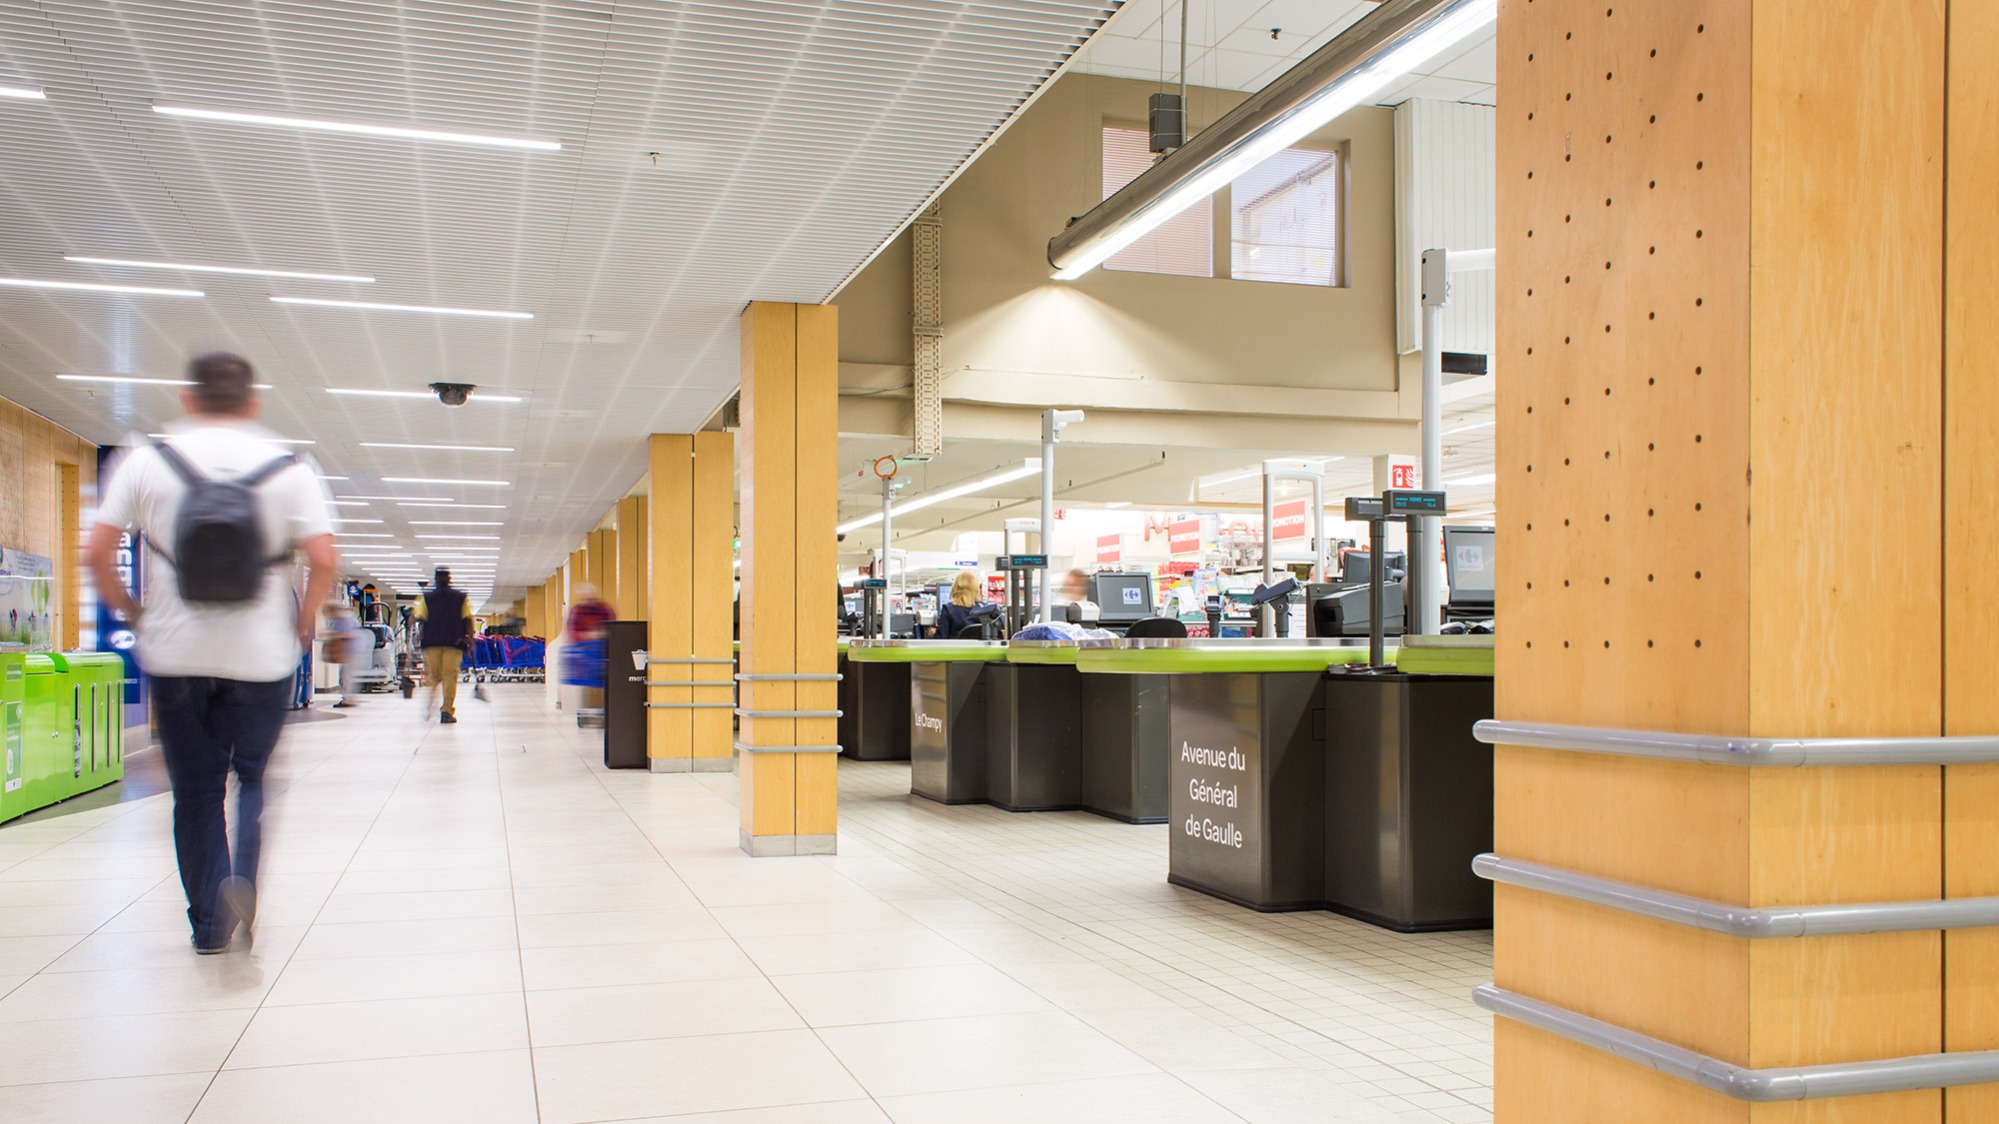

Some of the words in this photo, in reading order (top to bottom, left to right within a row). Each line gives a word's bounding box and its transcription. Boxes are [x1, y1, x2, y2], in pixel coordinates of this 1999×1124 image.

[1181, 741, 1227, 769] Avenue
[1228, 746, 1245, 771] du
[1189, 778, 1238, 808] Général
[1185, 813, 1201, 838] de
[1202, 818, 1243, 848] Gaulle
